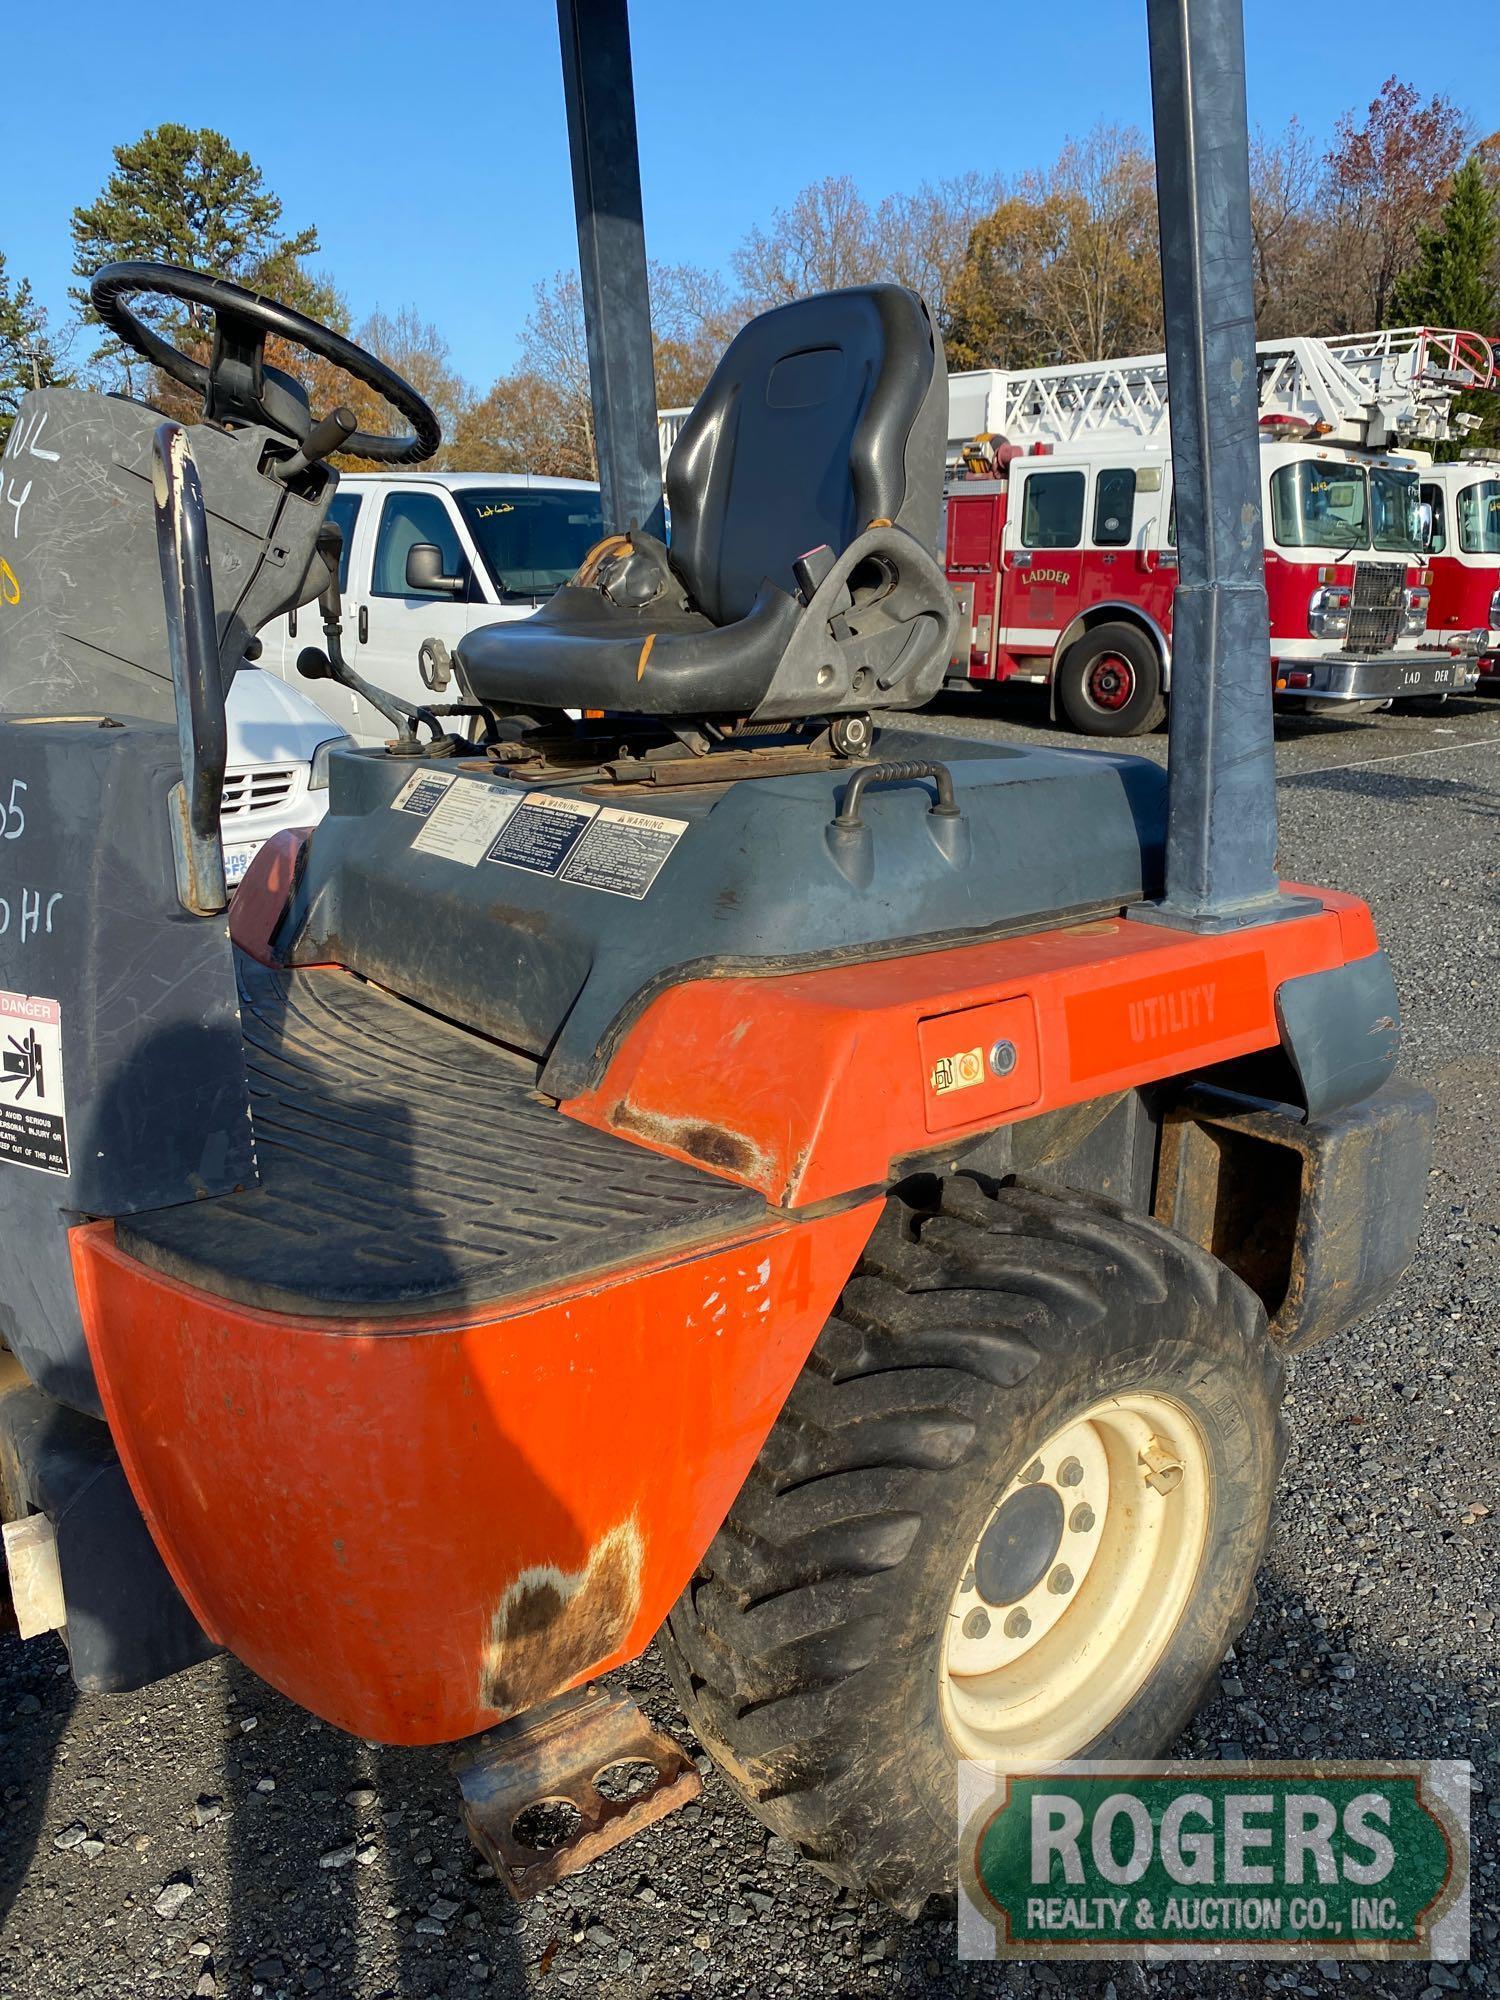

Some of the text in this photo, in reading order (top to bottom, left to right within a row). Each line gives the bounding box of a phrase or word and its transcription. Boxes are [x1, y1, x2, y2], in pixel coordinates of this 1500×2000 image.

[1021, 569, 1070, 586] LADDER
[1404, 670, 1449, 685] LAD DER
[549, 799, 579, 812] WARNING
[626, 816, 664, 830] WARNING
[2, 998, 51, 1018] DANGER
[1129, 982, 1216, 1043] UTILITY
[5, 1110, 22, 1121] AVOID
[25, 1115, 51, 1128] SERIOUS
[28, 1127, 50, 1139] INJURY
[52, 1132, 62, 1142] OR
[12, 1145, 22, 1154] OUT
[25, 1148, 32, 1156] OF
[34, 1150, 46, 1160] THIS
[49, 1154, 63, 1164] AREA
